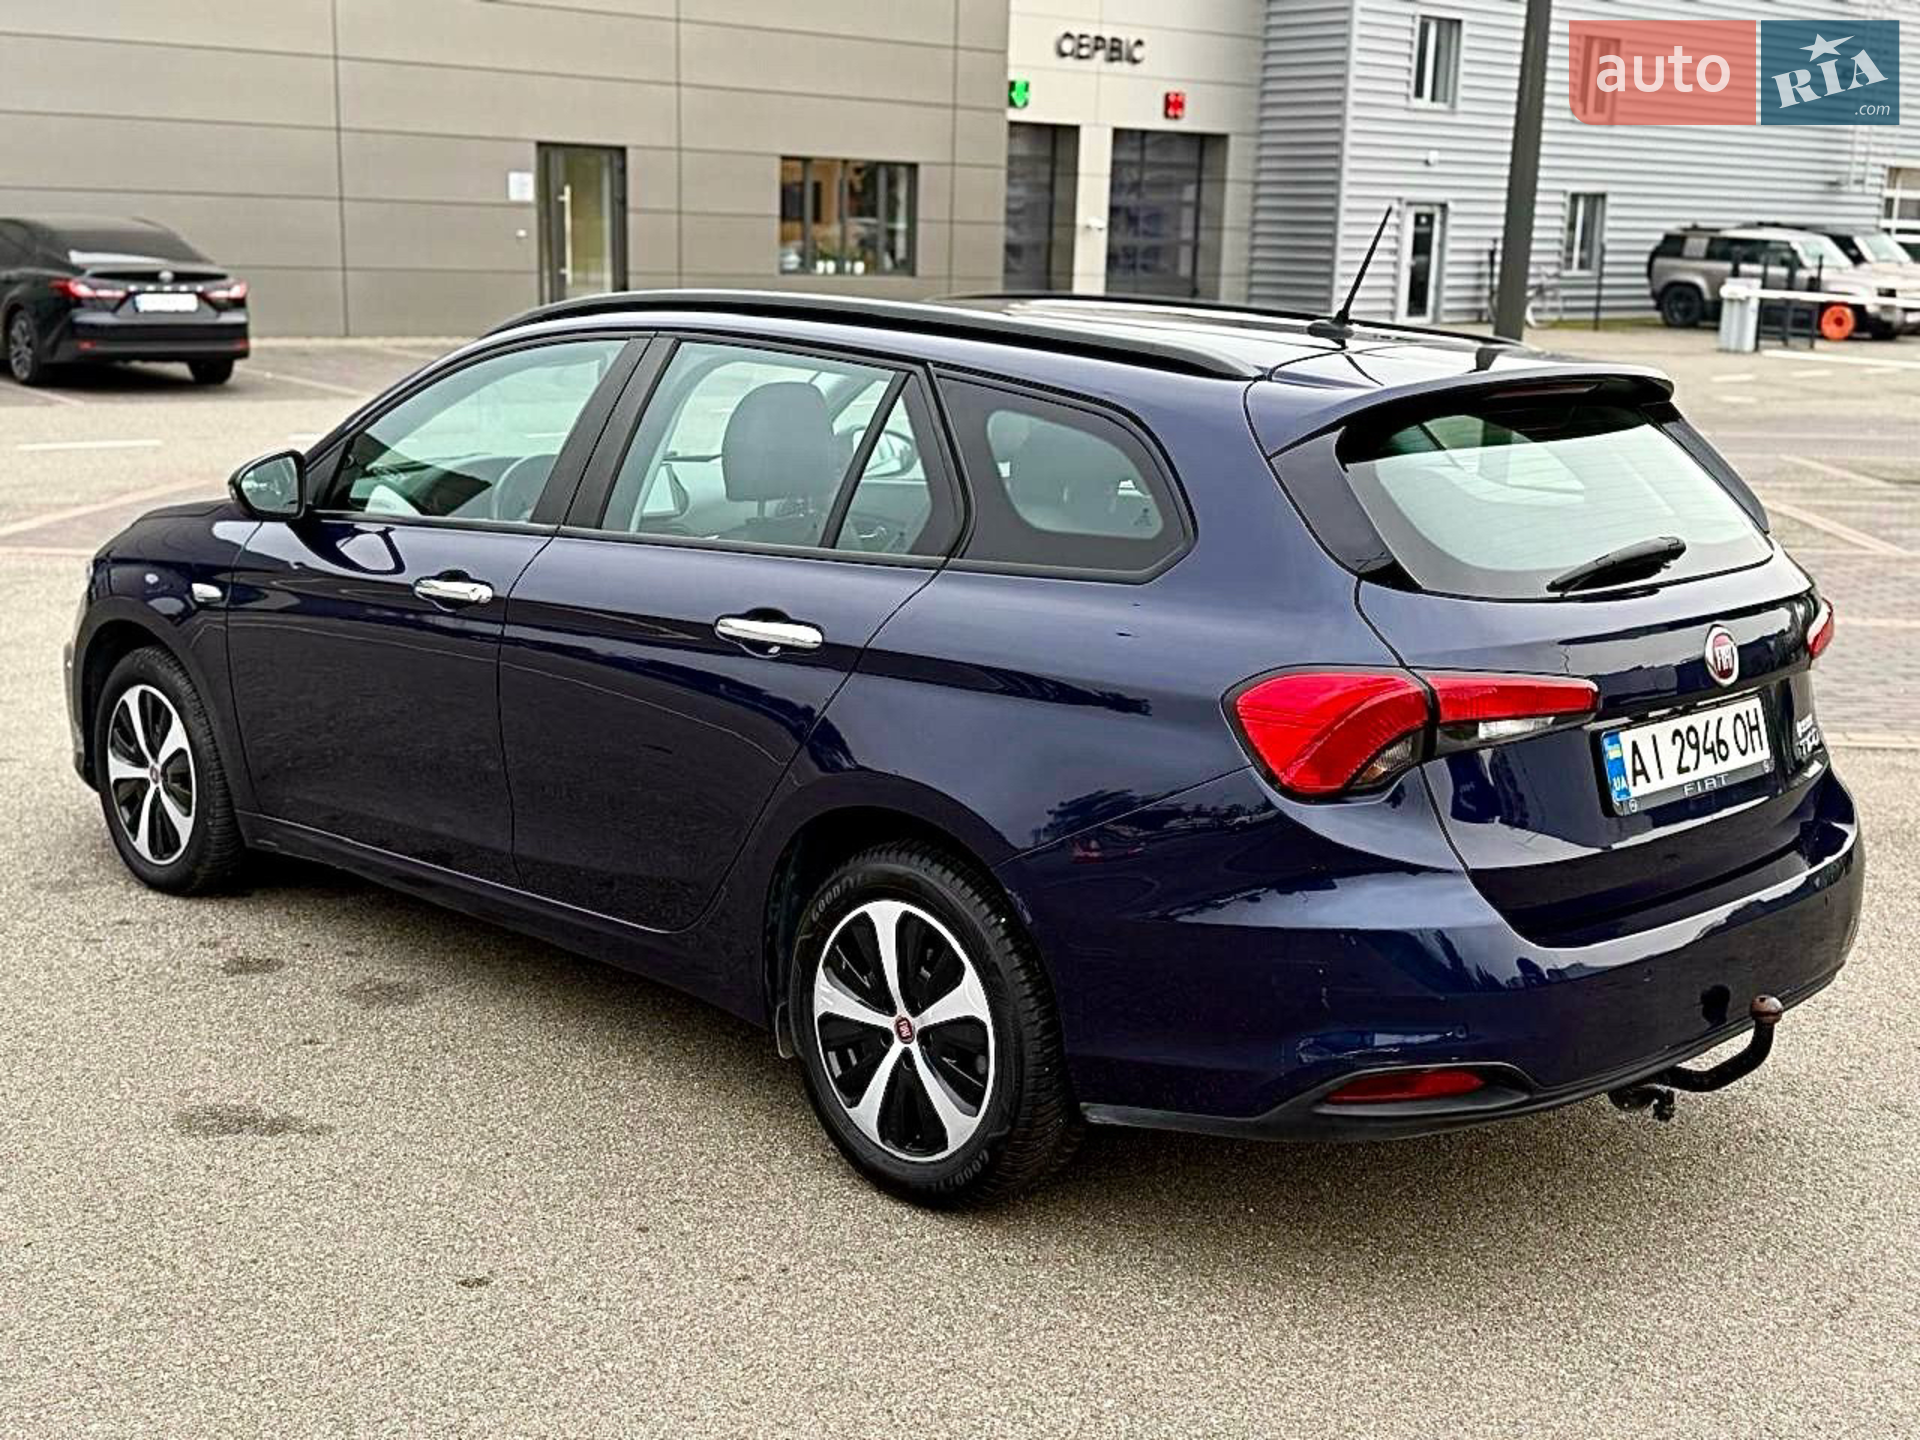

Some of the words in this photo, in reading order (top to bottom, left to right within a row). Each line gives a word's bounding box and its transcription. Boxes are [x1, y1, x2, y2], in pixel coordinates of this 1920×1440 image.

[1055, 31, 1145, 65] СЕРВІС
[1631, 733, 1664, 787] AI
[1671, 716, 1729, 775] 2946
[1733, 707, 1764, 757] OH
[1613, 775, 1629, 791] UA
[1683, 773, 1729, 797] FIAT
